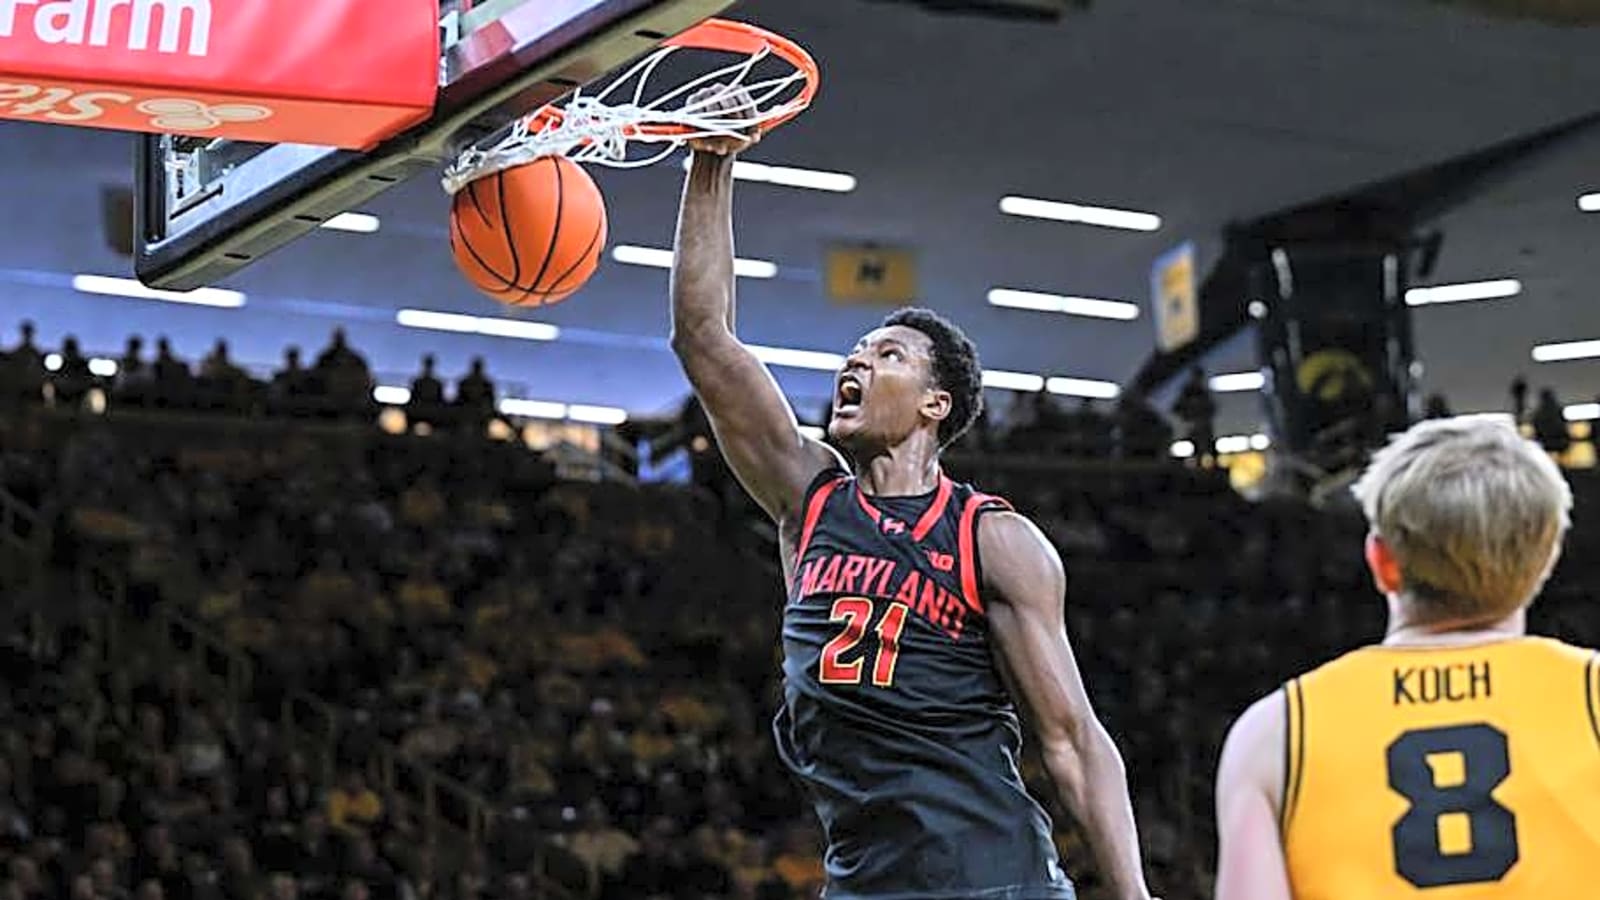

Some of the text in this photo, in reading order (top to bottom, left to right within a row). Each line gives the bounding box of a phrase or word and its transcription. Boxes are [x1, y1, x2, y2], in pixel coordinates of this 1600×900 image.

[800, 554, 966, 639] MARYLAND
[819, 597, 909, 687] 21
[1393, 661, 1491, 706] KOCH
[1385, 722, 1520, 889] 8
